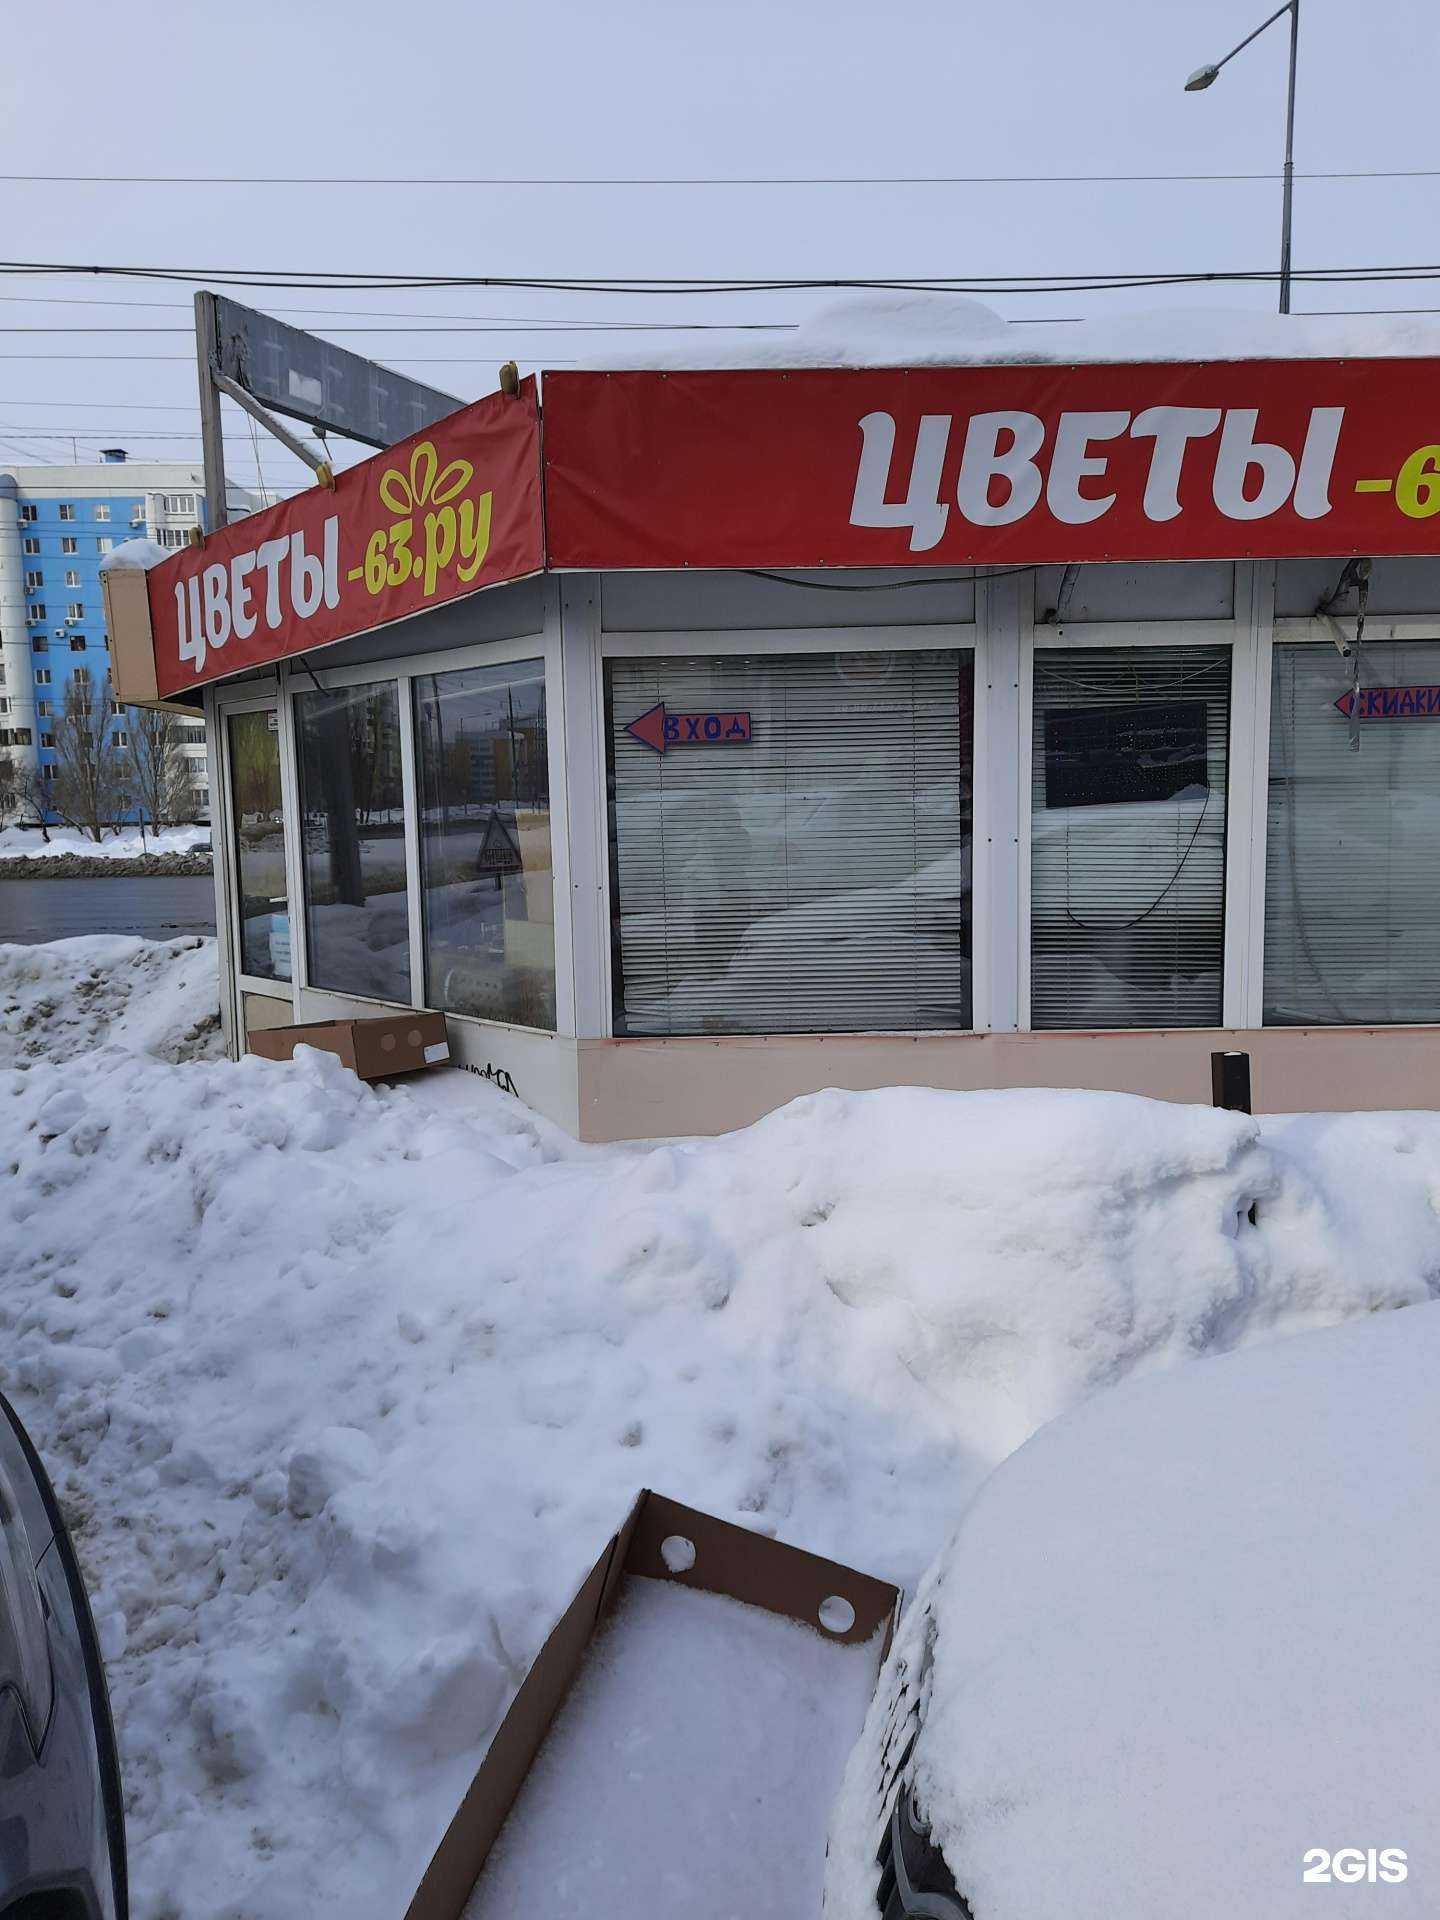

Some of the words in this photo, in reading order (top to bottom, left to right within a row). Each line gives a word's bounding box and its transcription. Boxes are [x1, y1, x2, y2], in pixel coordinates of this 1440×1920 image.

[849, 406, 1345, 552] ЦВЕТЫ
[175, 515, 340, 673] ЦВЕТЫ
[664, 716, 746, 740] ВХОД
